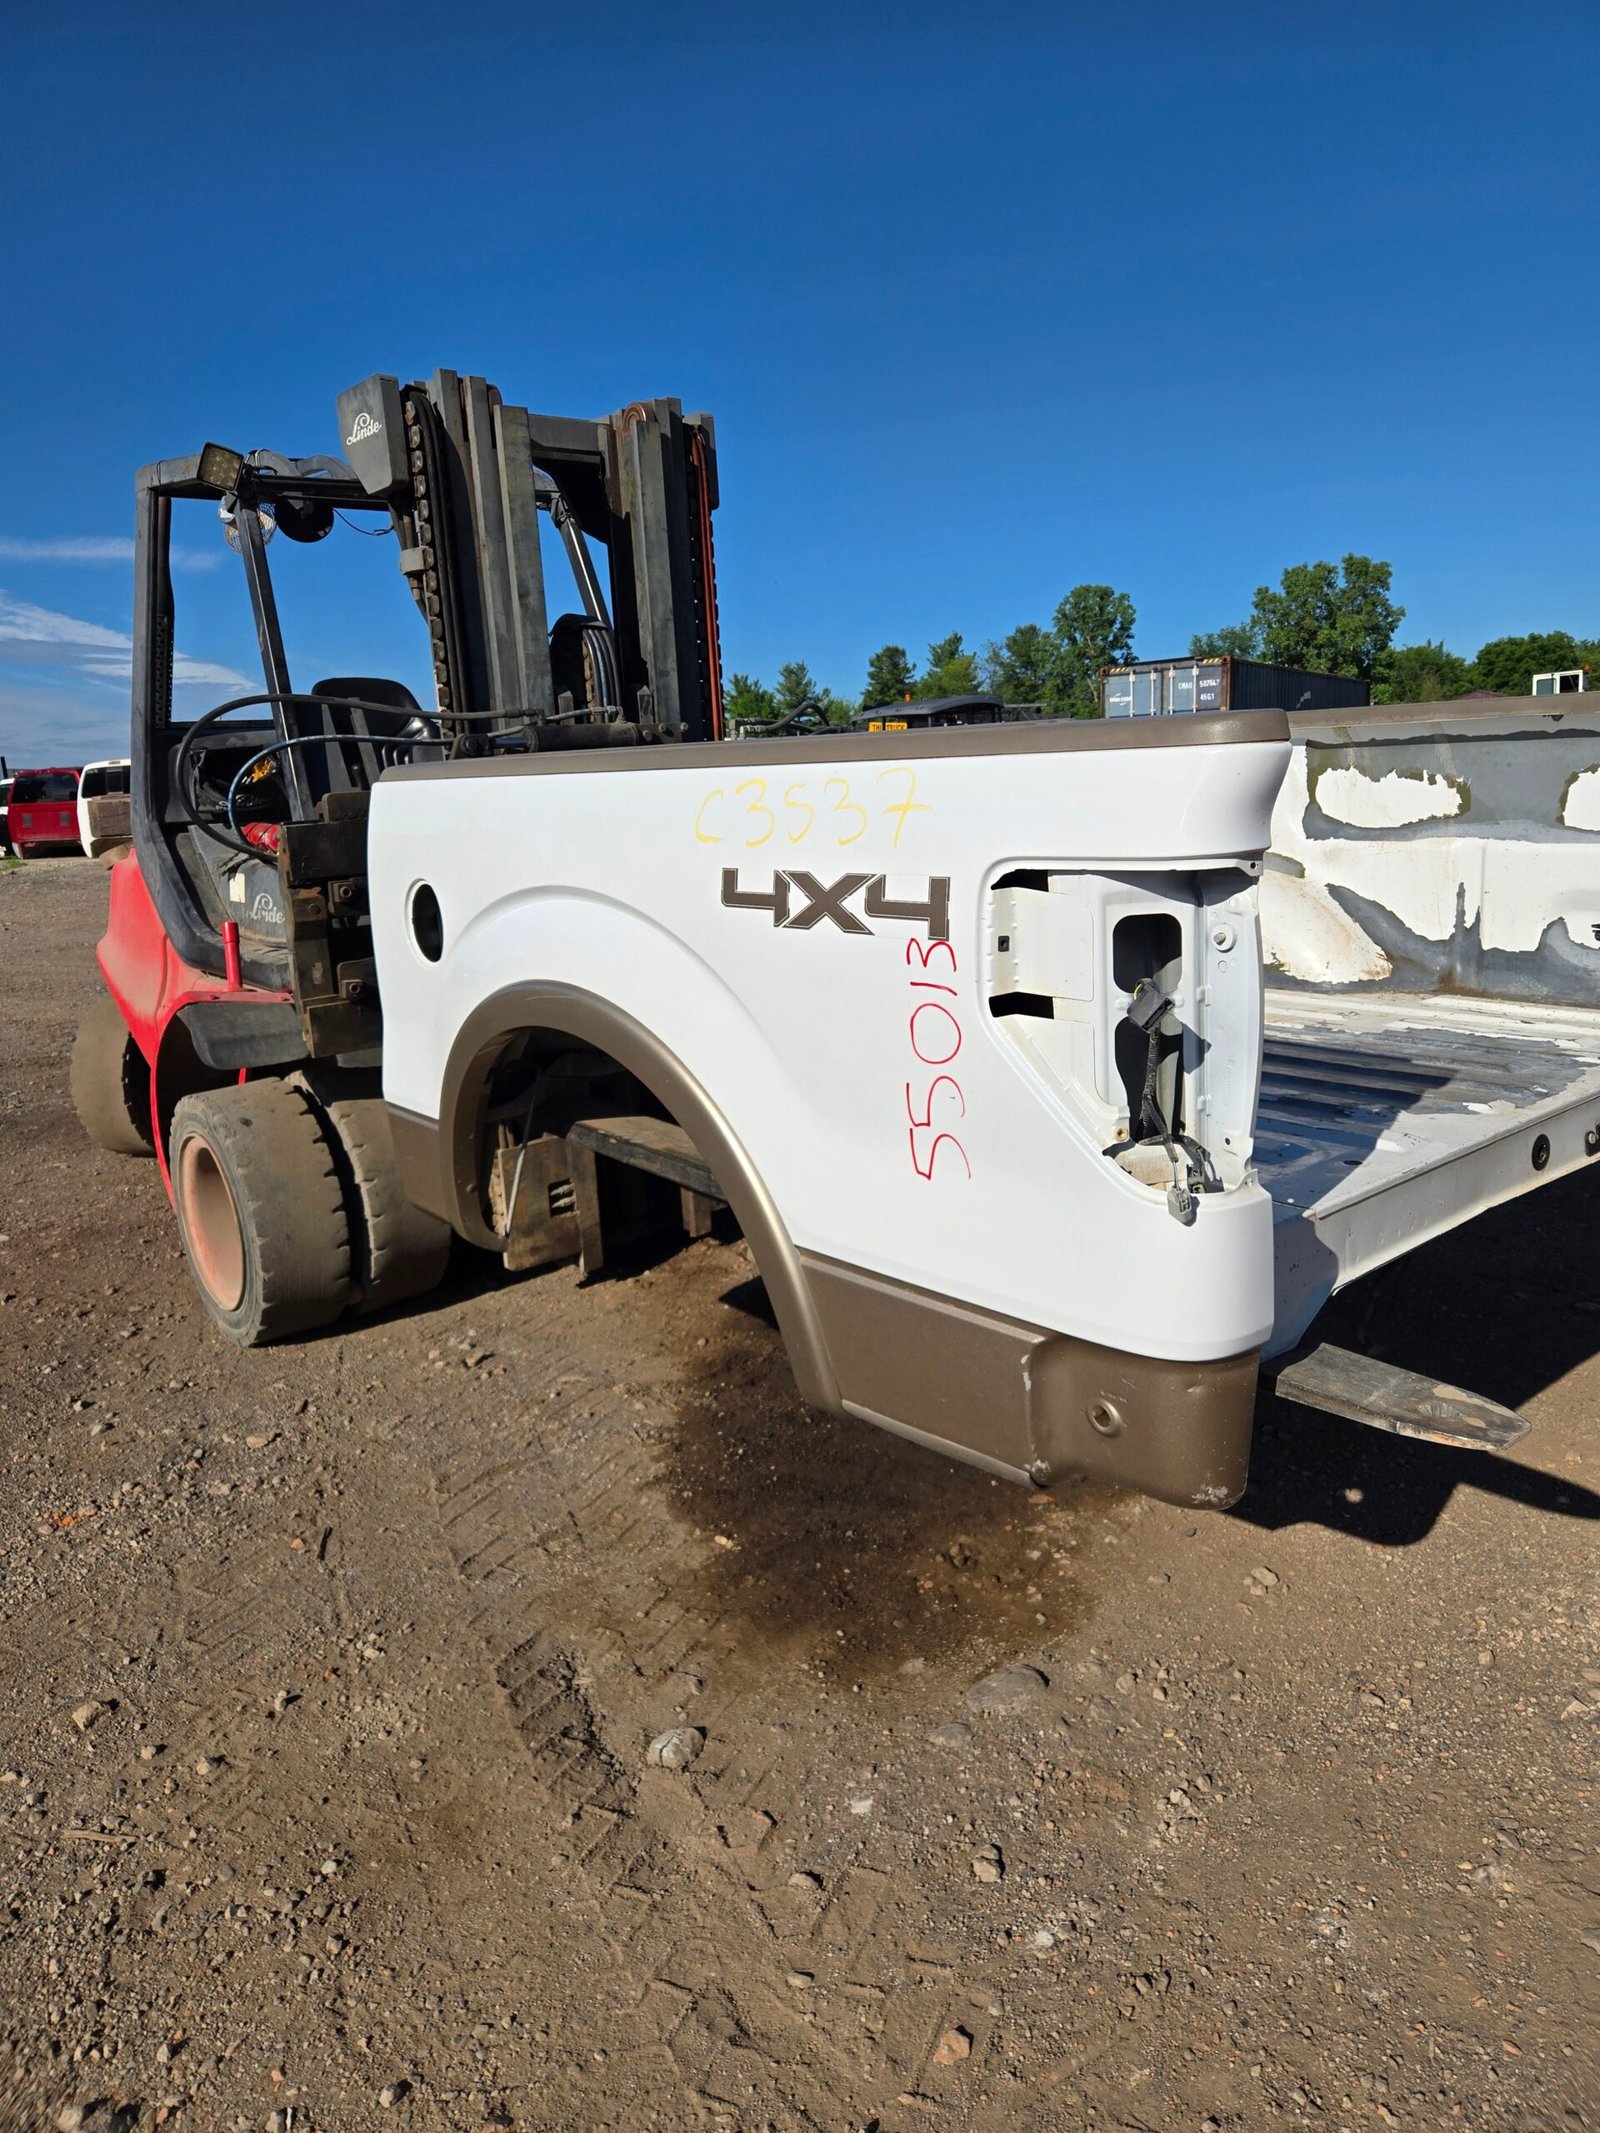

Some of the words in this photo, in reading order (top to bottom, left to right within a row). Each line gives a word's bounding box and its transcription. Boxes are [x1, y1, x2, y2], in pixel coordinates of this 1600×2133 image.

[346, 412, 382, 446] Linde
[246, 892, 286, 925] Linde
[905, 937, 971, 1181] 55013
